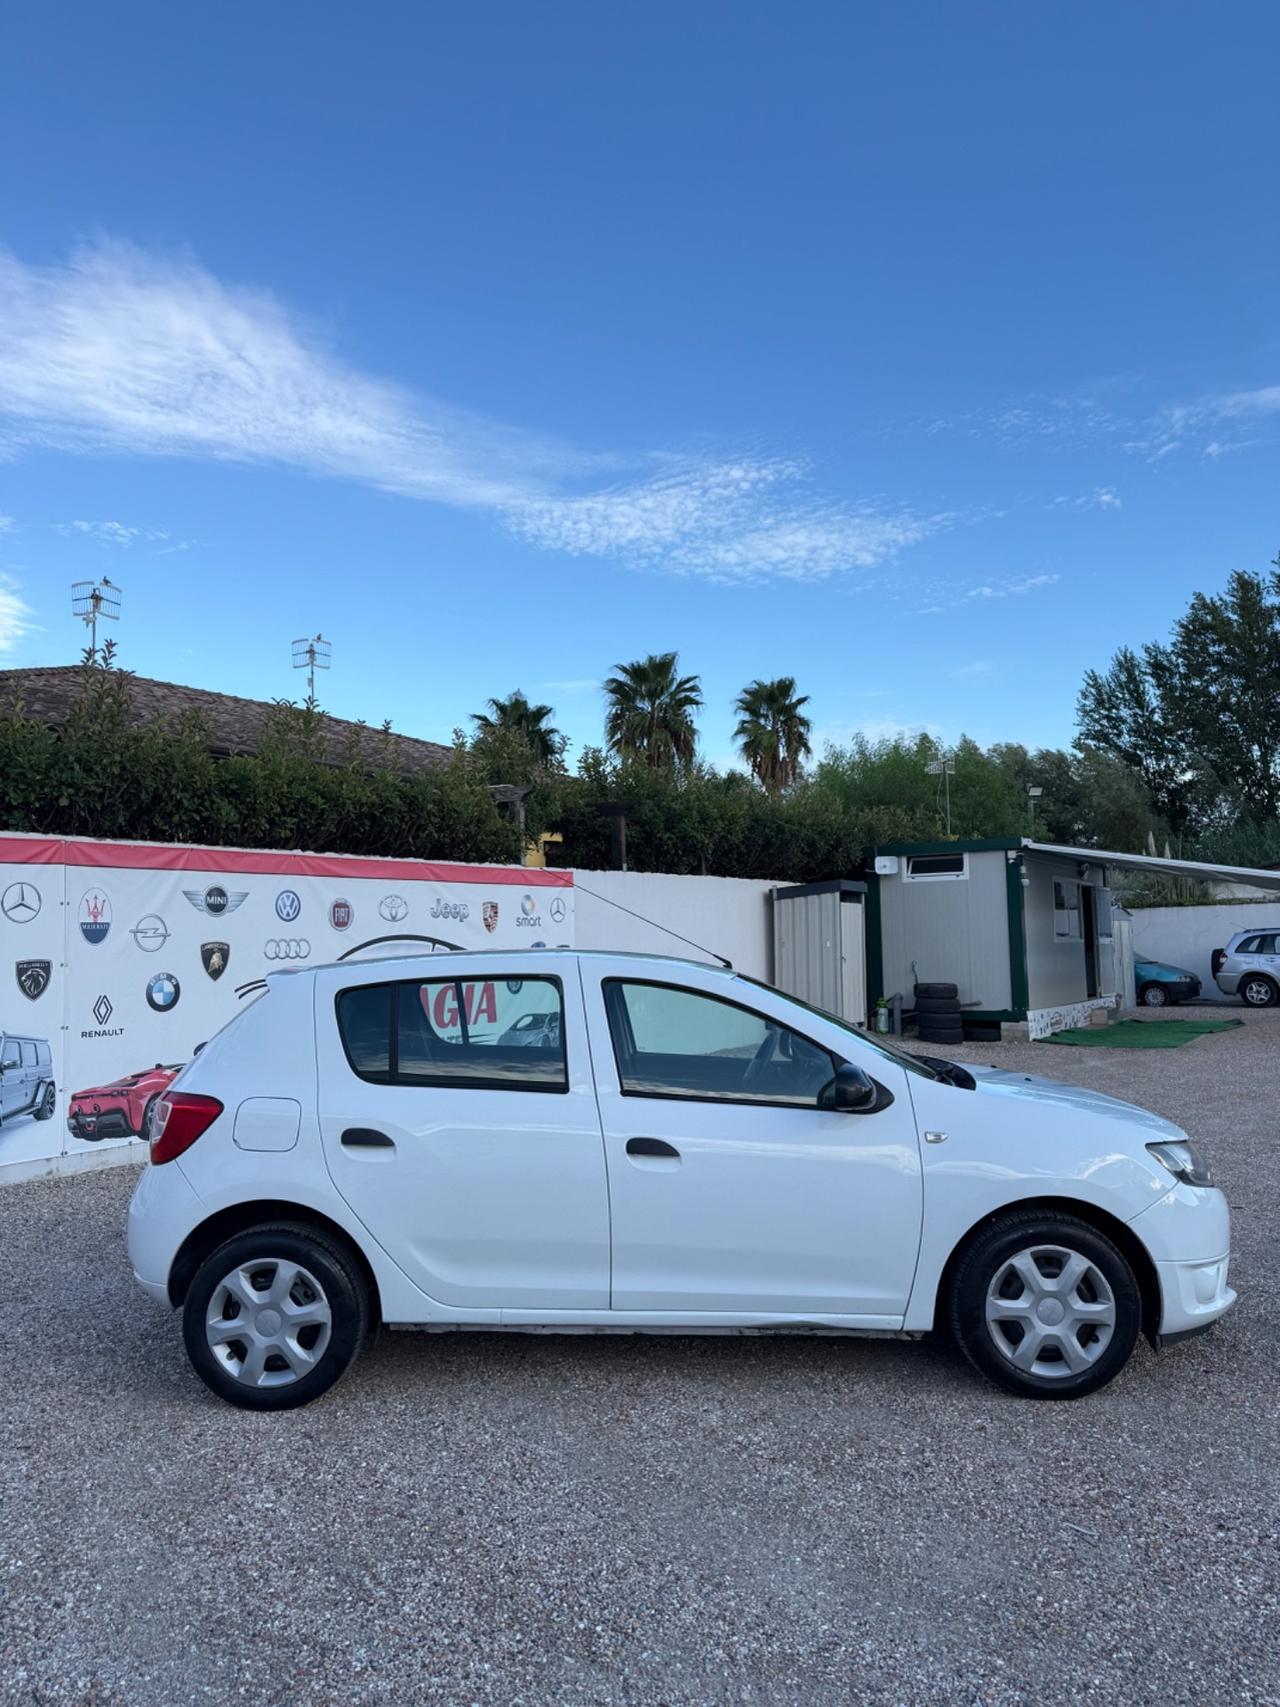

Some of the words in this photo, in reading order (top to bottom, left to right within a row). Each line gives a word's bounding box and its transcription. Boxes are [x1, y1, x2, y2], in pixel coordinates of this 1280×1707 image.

[206, 896, 228, 904] MINI
[335, 907, 349, 923] FIAT
[430, 898, 469, 922] Jeep
[515, 917, 542, 927] smart
[81, 1028, 124, 1039] RENAULT
